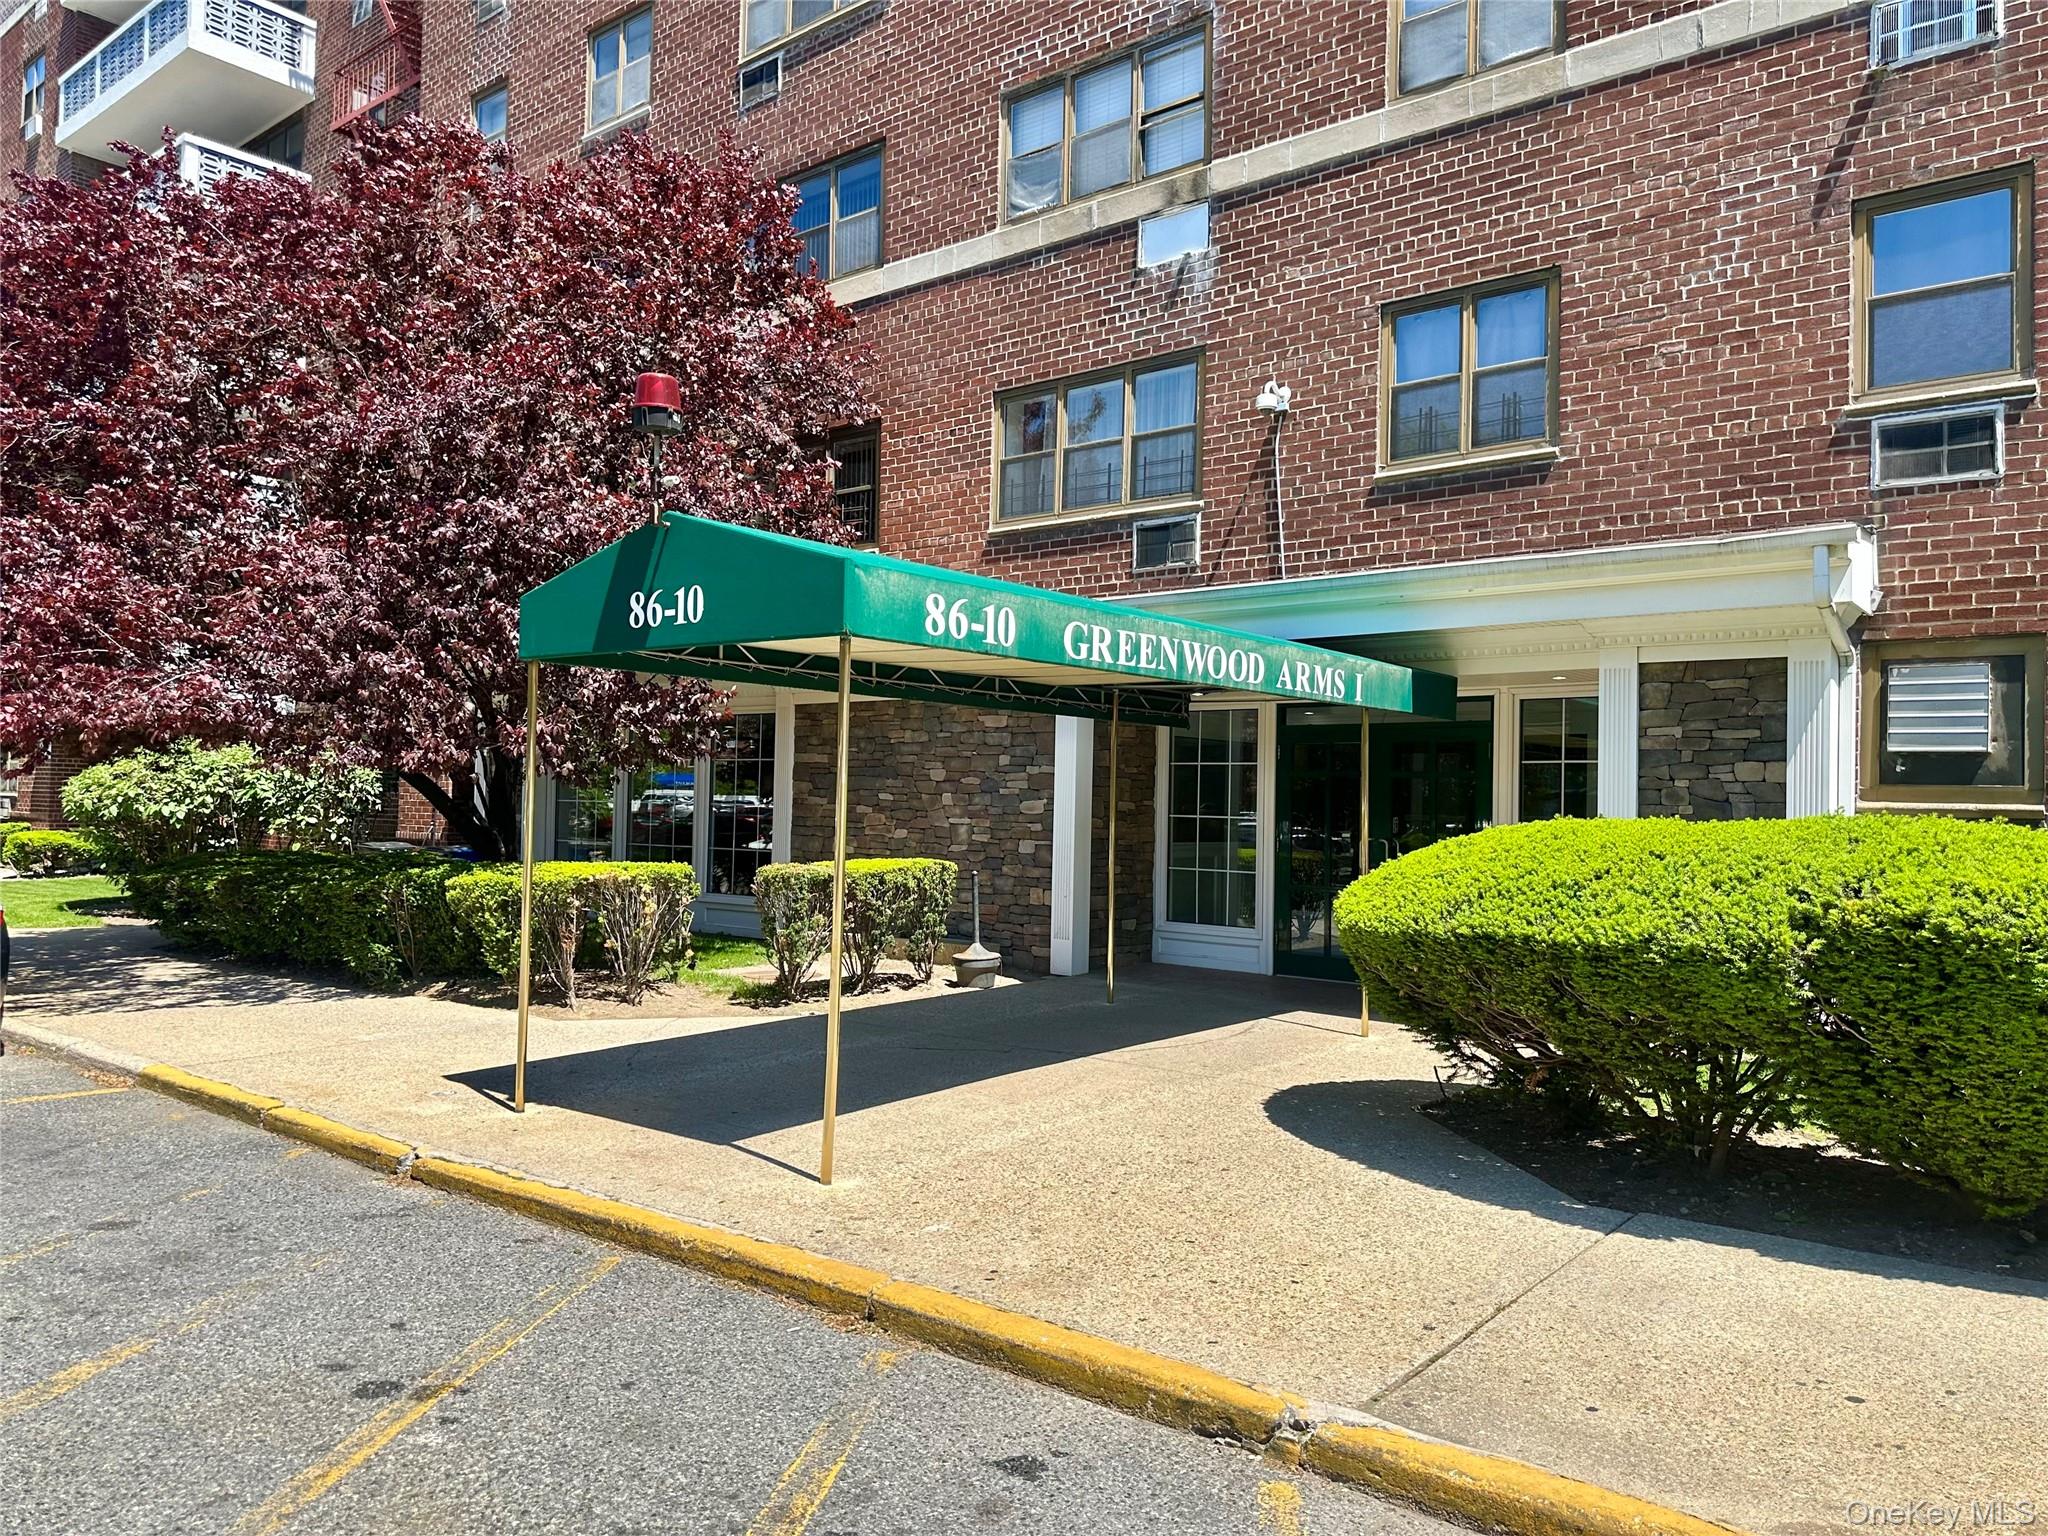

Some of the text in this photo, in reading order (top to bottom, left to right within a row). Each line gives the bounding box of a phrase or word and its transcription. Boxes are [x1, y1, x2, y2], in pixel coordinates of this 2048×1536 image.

[629, 585, 704, 629] 86-10
[924, 593, 1365, 702] 86-10 GREENWOOD ARMS I
